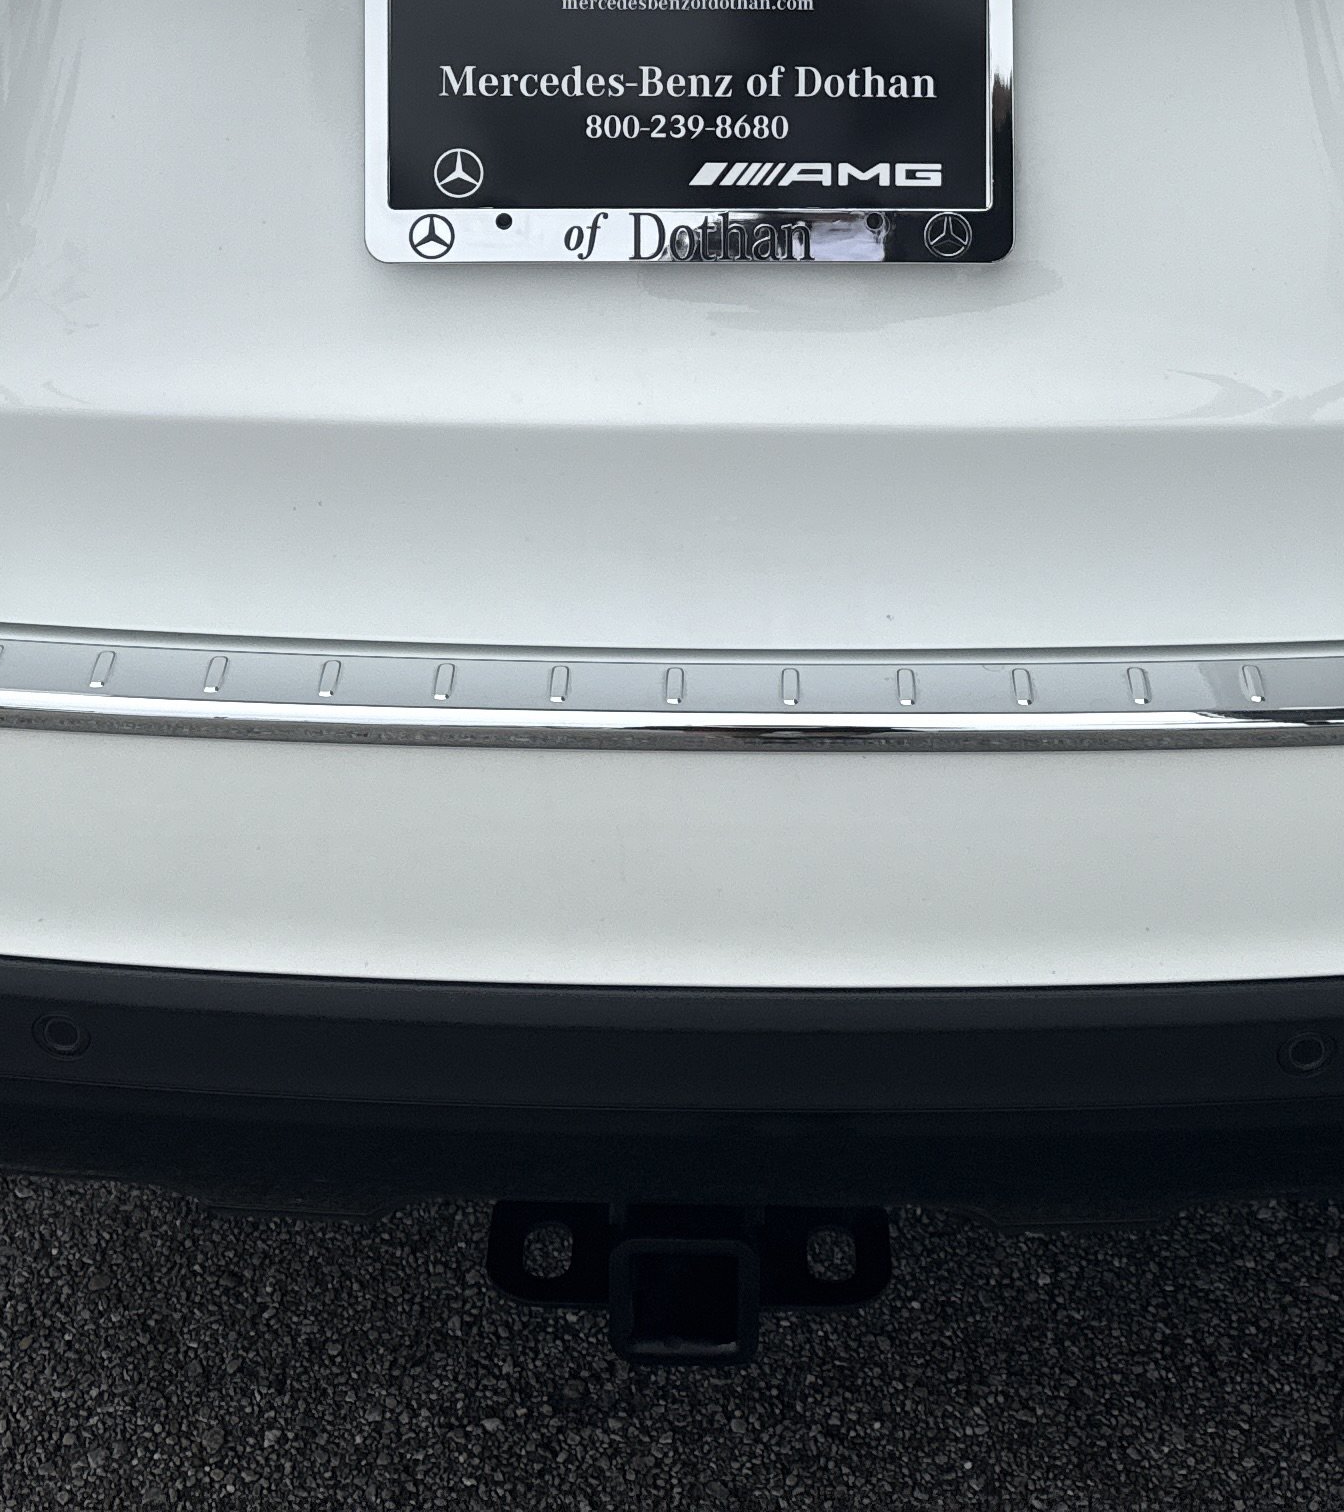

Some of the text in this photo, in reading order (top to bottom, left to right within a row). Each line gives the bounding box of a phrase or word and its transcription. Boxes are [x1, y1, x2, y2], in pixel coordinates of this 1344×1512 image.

[438, 65, 937, 99] Mercedes-Benz of Dothan
[585, 114, 789, 140] 800-239-8680
[778, 162, 943, 187] AMG
[563, 211, 816, 262] of Dothan
